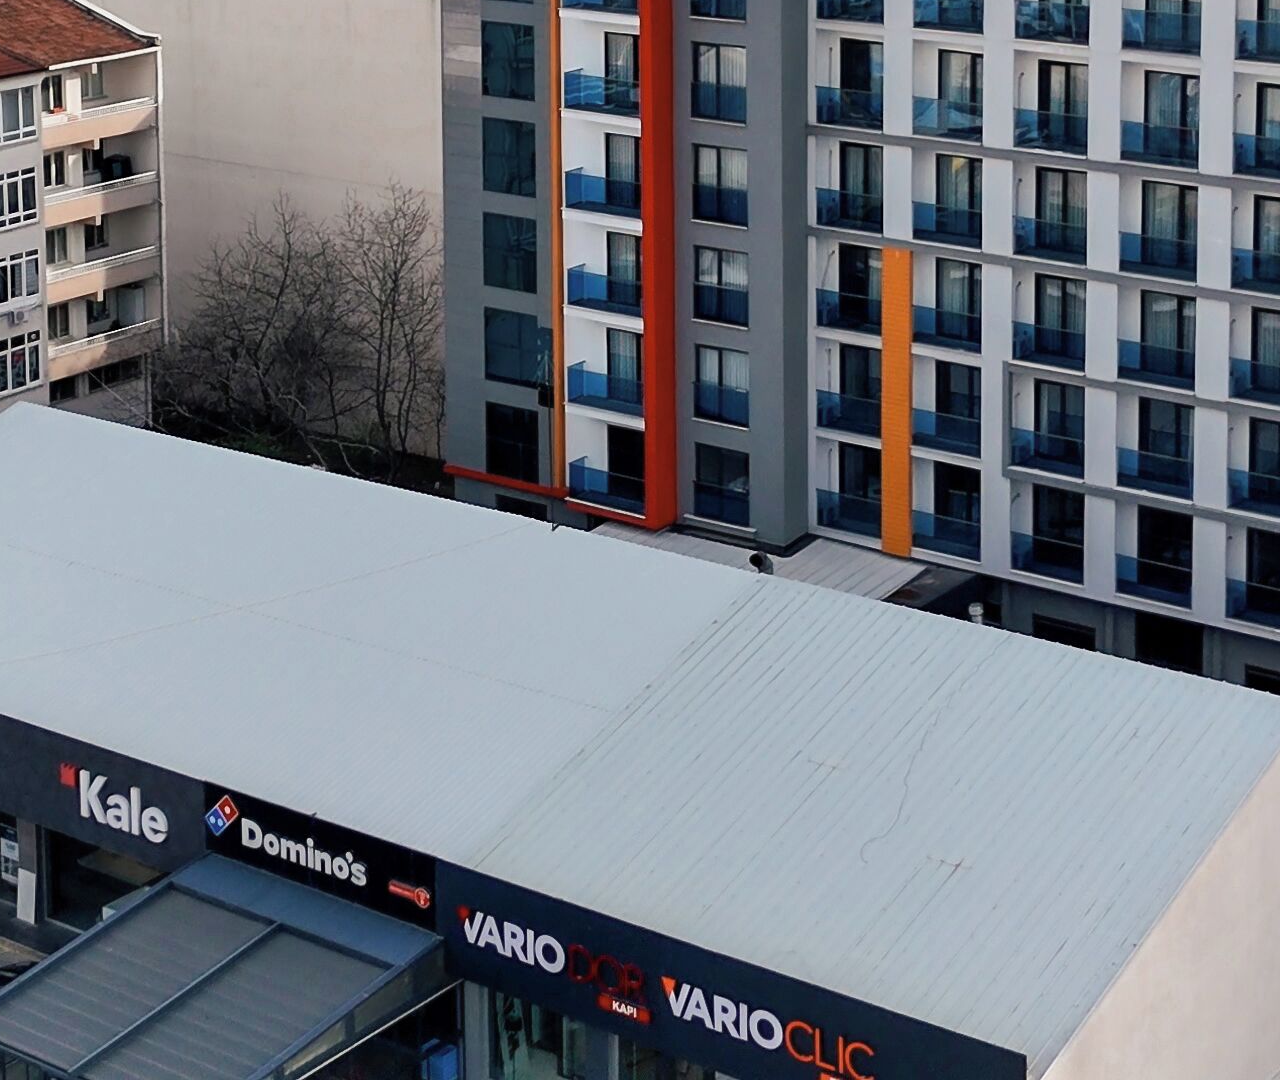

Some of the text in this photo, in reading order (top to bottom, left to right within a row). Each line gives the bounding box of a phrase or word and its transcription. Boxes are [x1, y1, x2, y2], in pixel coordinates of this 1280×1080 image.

[79, 768, 169, 845] Kale
[241, 817, 369, 888] Domino's
[611, 999, 638, 1019] KAPI
